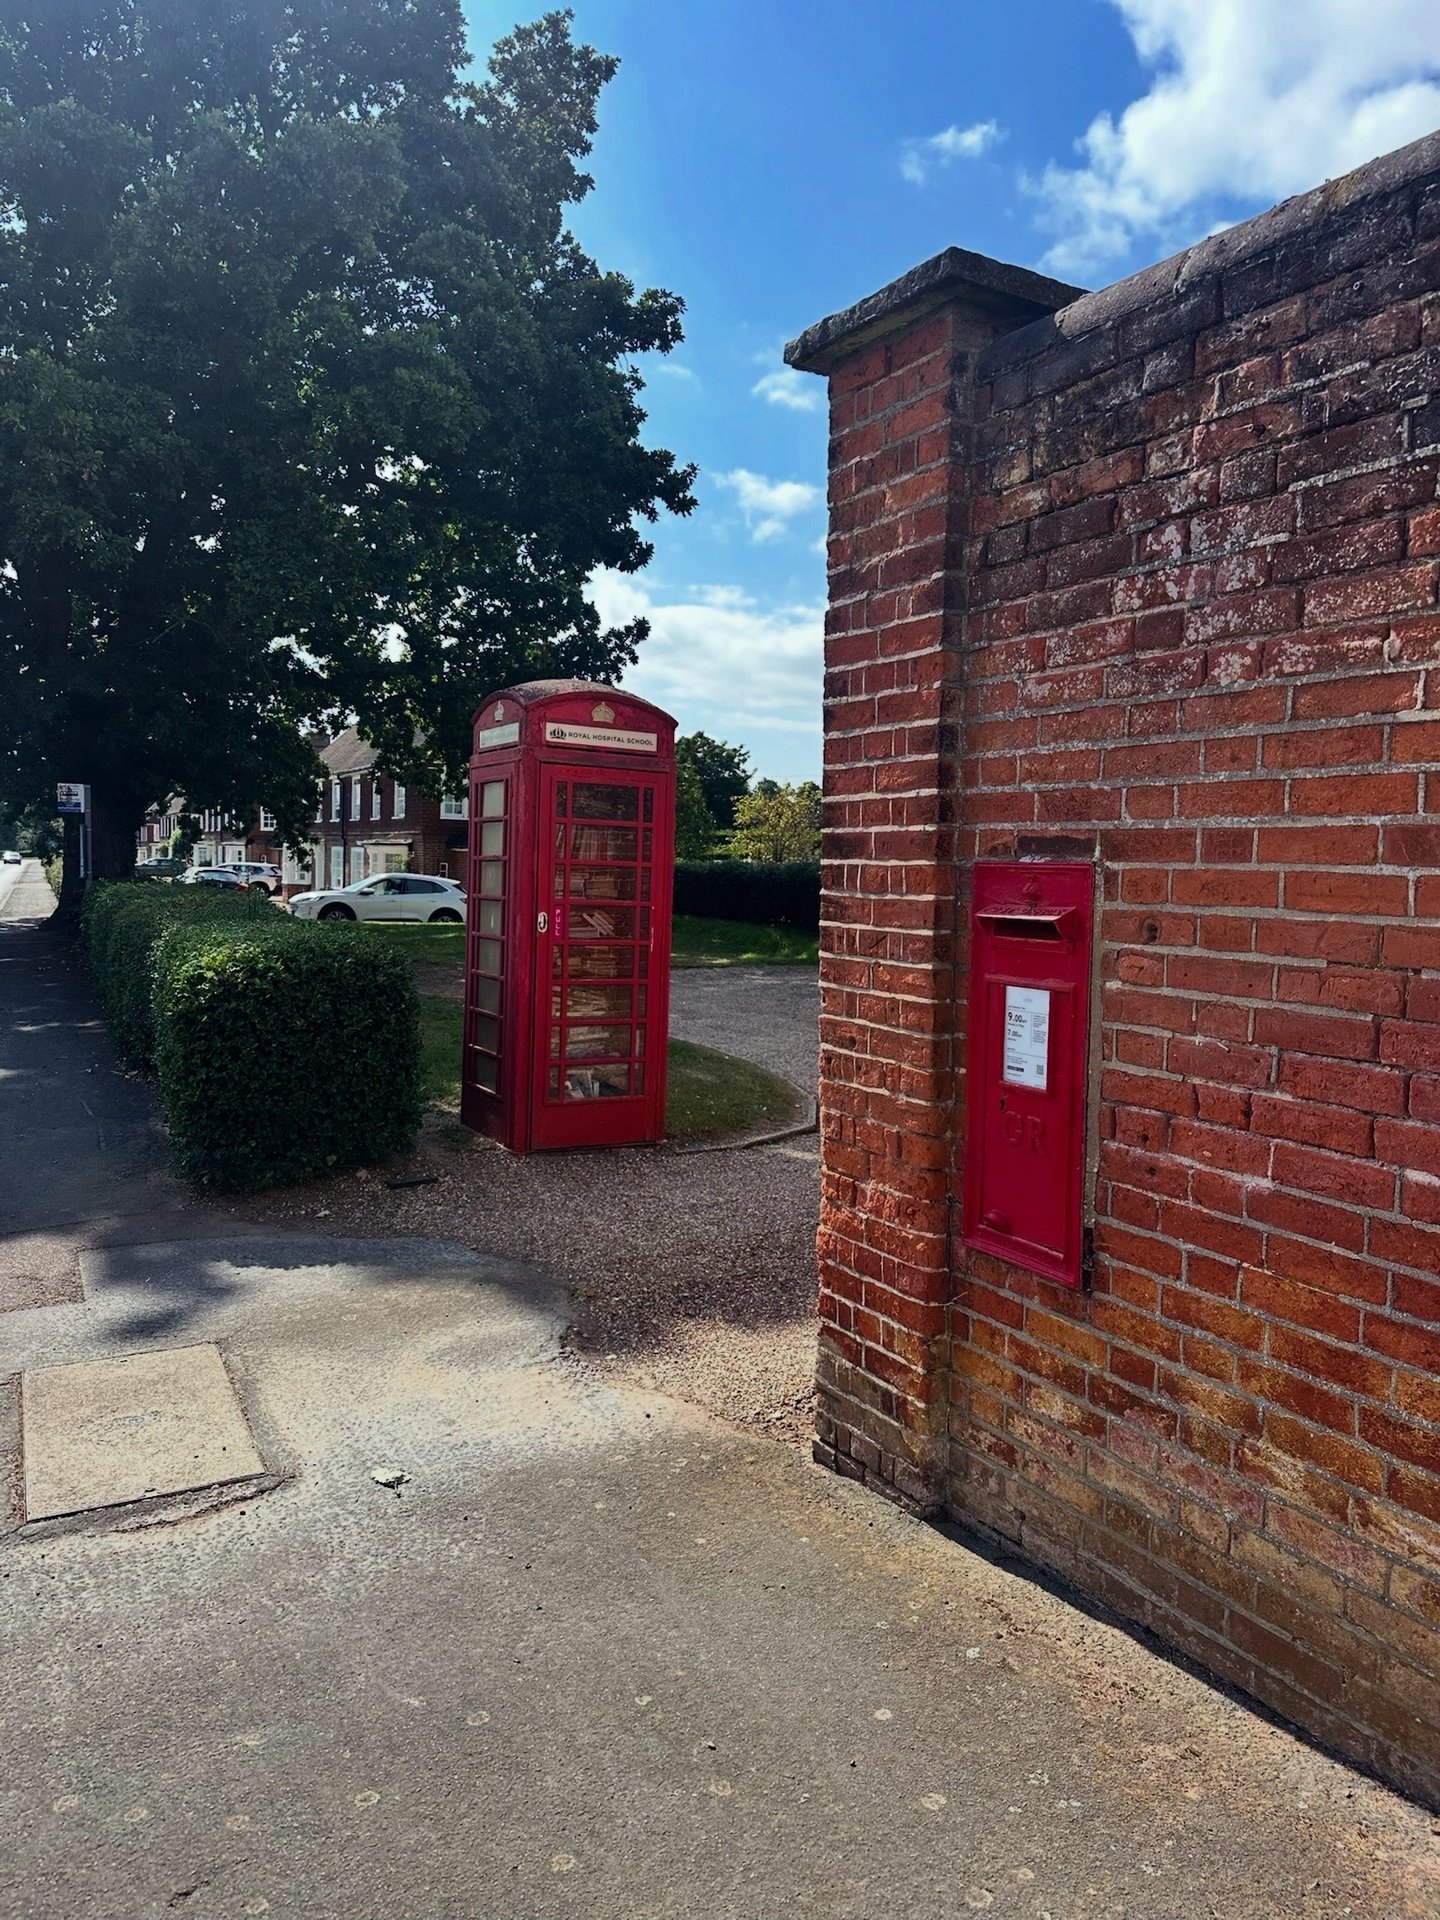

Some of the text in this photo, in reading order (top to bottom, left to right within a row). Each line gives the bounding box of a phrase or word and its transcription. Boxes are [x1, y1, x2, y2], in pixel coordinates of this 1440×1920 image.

[568, 731, 653, 746] ROYAL HOSPITAL SCHOOL
[1004, 1110, 1049, 1157] GR
